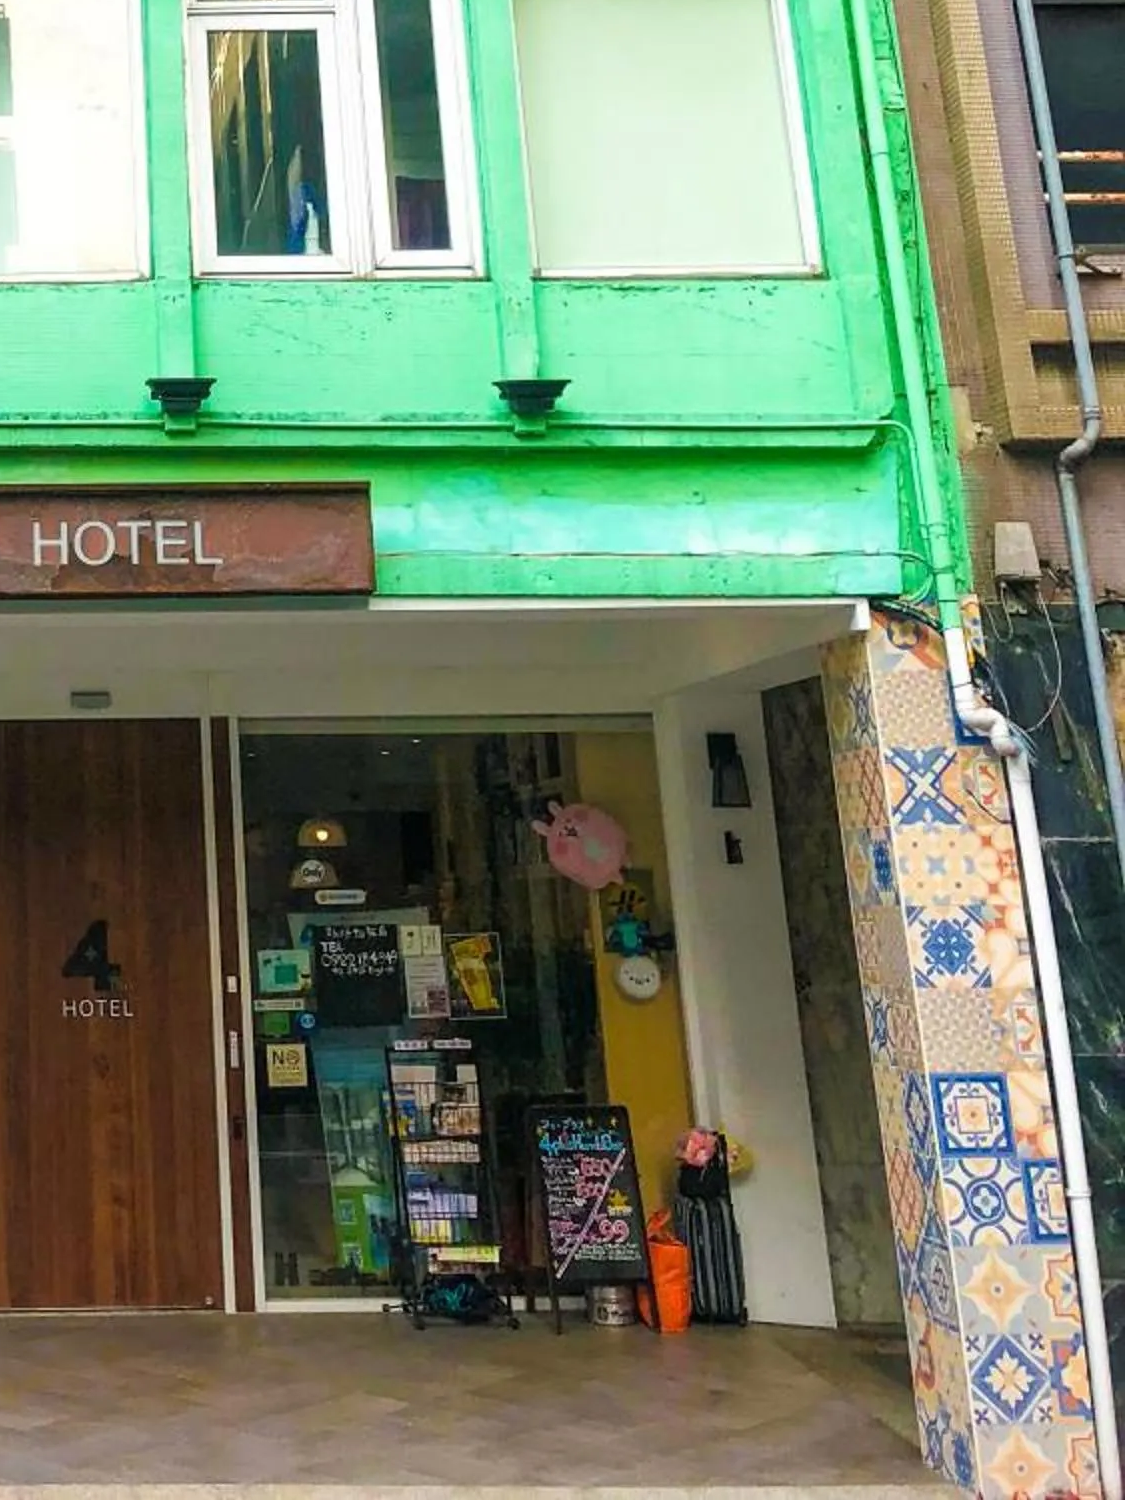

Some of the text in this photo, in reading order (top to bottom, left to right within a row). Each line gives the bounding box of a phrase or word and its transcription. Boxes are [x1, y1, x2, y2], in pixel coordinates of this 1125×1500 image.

[32, 520, 225, 567] HOTEL
[61, 919, 122, 991] 4
[61, 998, 135, 1018] HOTEL
